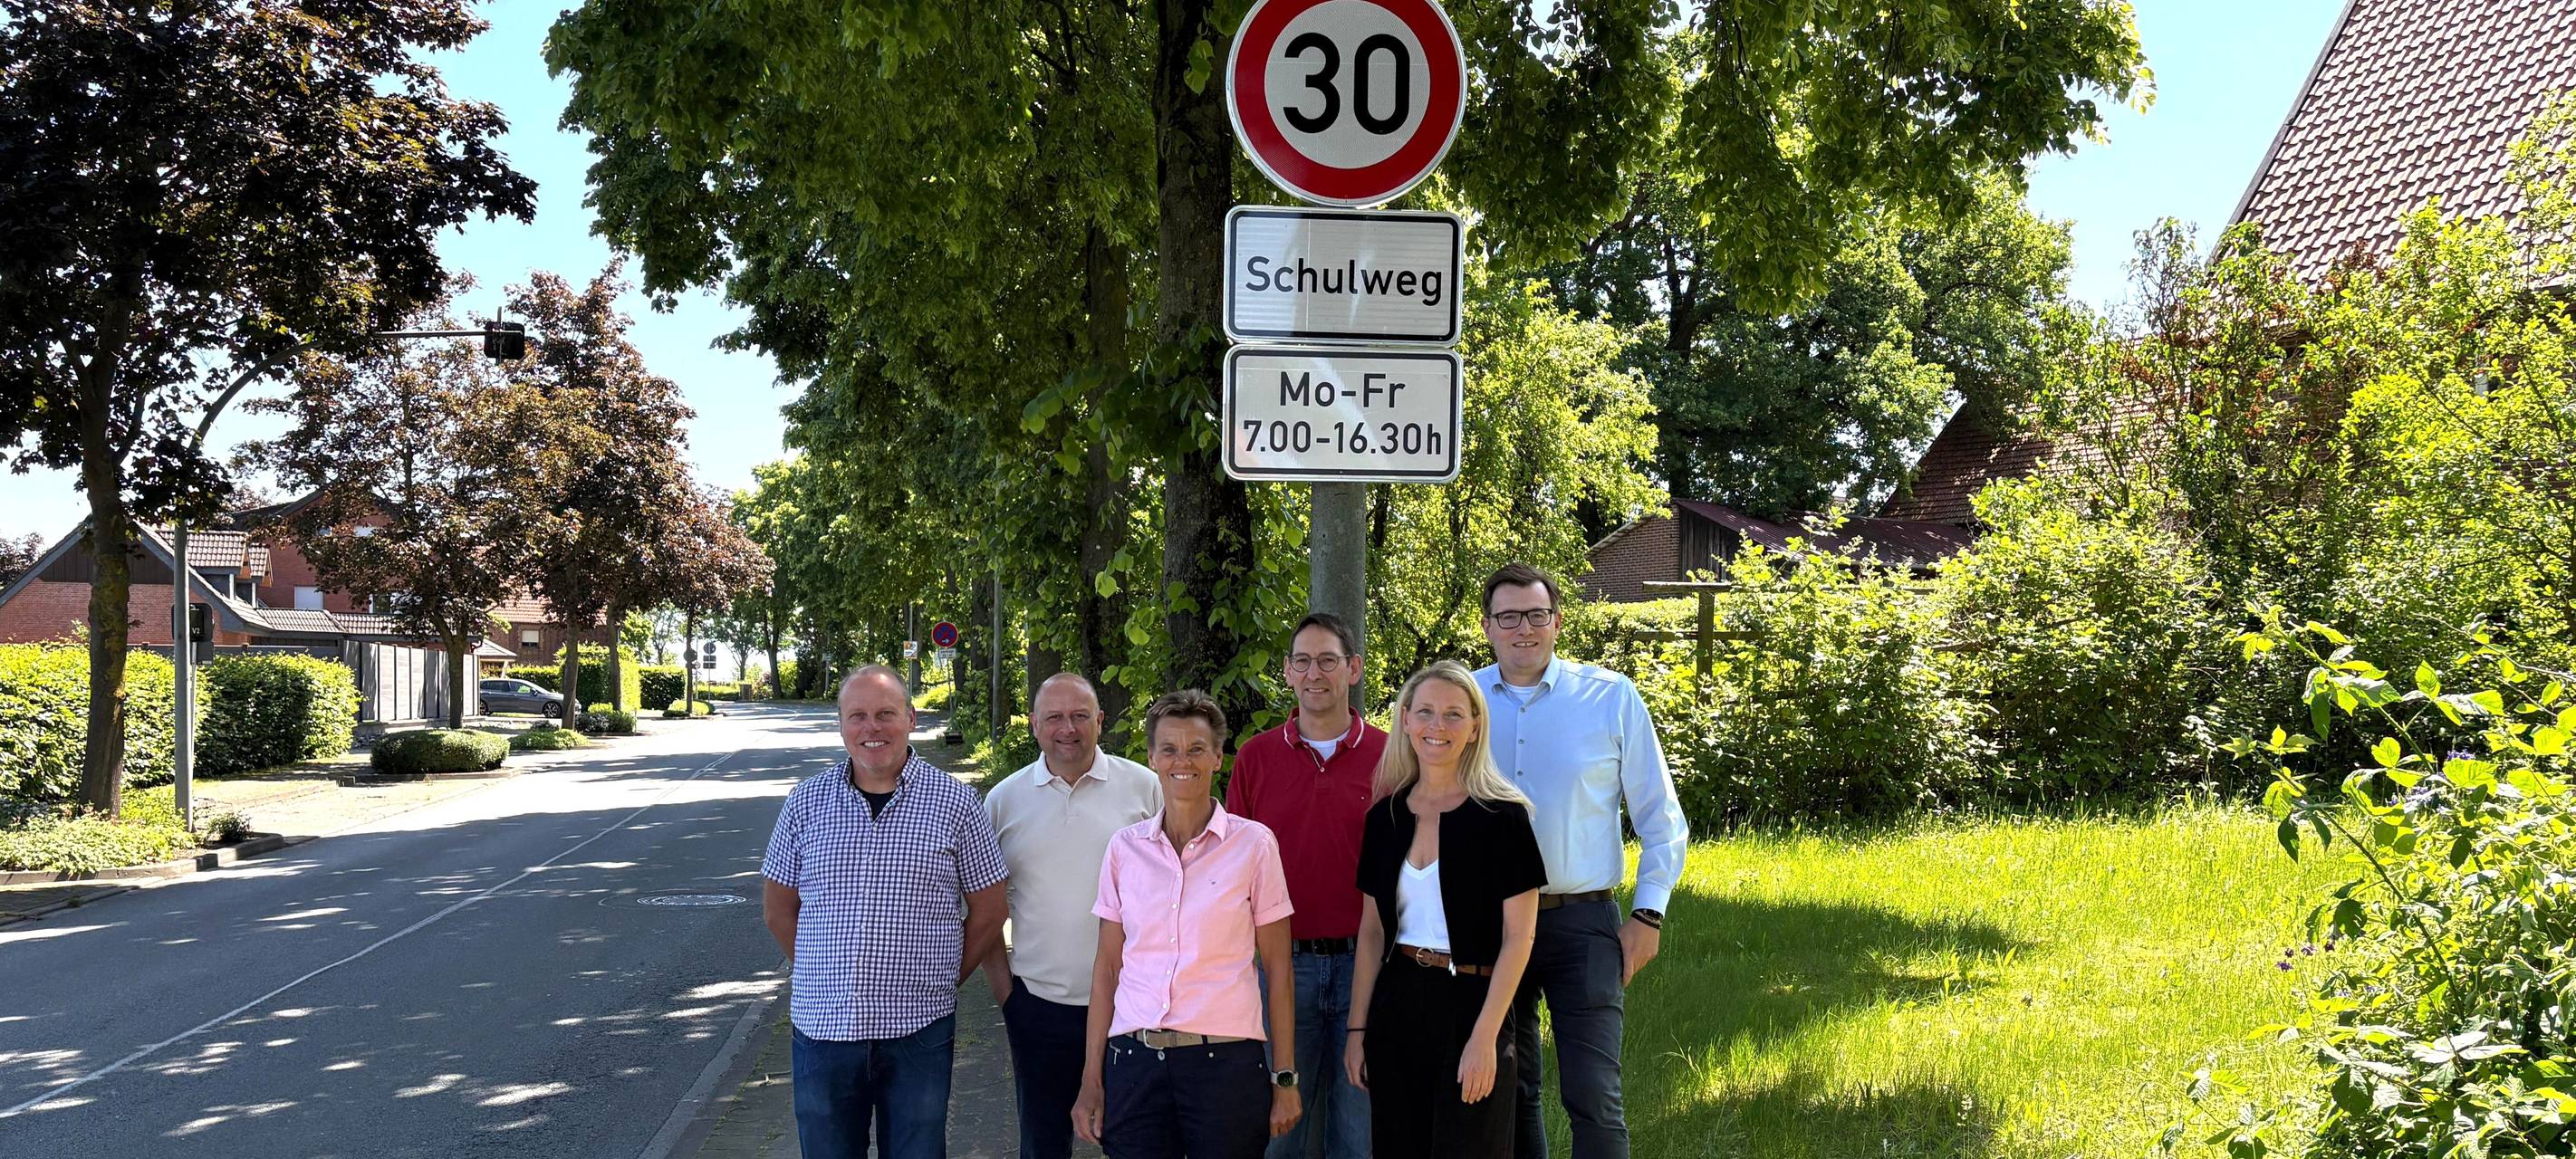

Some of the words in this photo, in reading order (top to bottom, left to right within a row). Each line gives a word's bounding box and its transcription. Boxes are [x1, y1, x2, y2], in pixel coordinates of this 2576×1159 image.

[1283, 33, 1410, 135] 30
[1246, 256, 1442, 307] Schulweg
[1280, 371, 1406, 408] Mo-Fr
[1244, 420, 1442, 455] 7.00-16.30h
